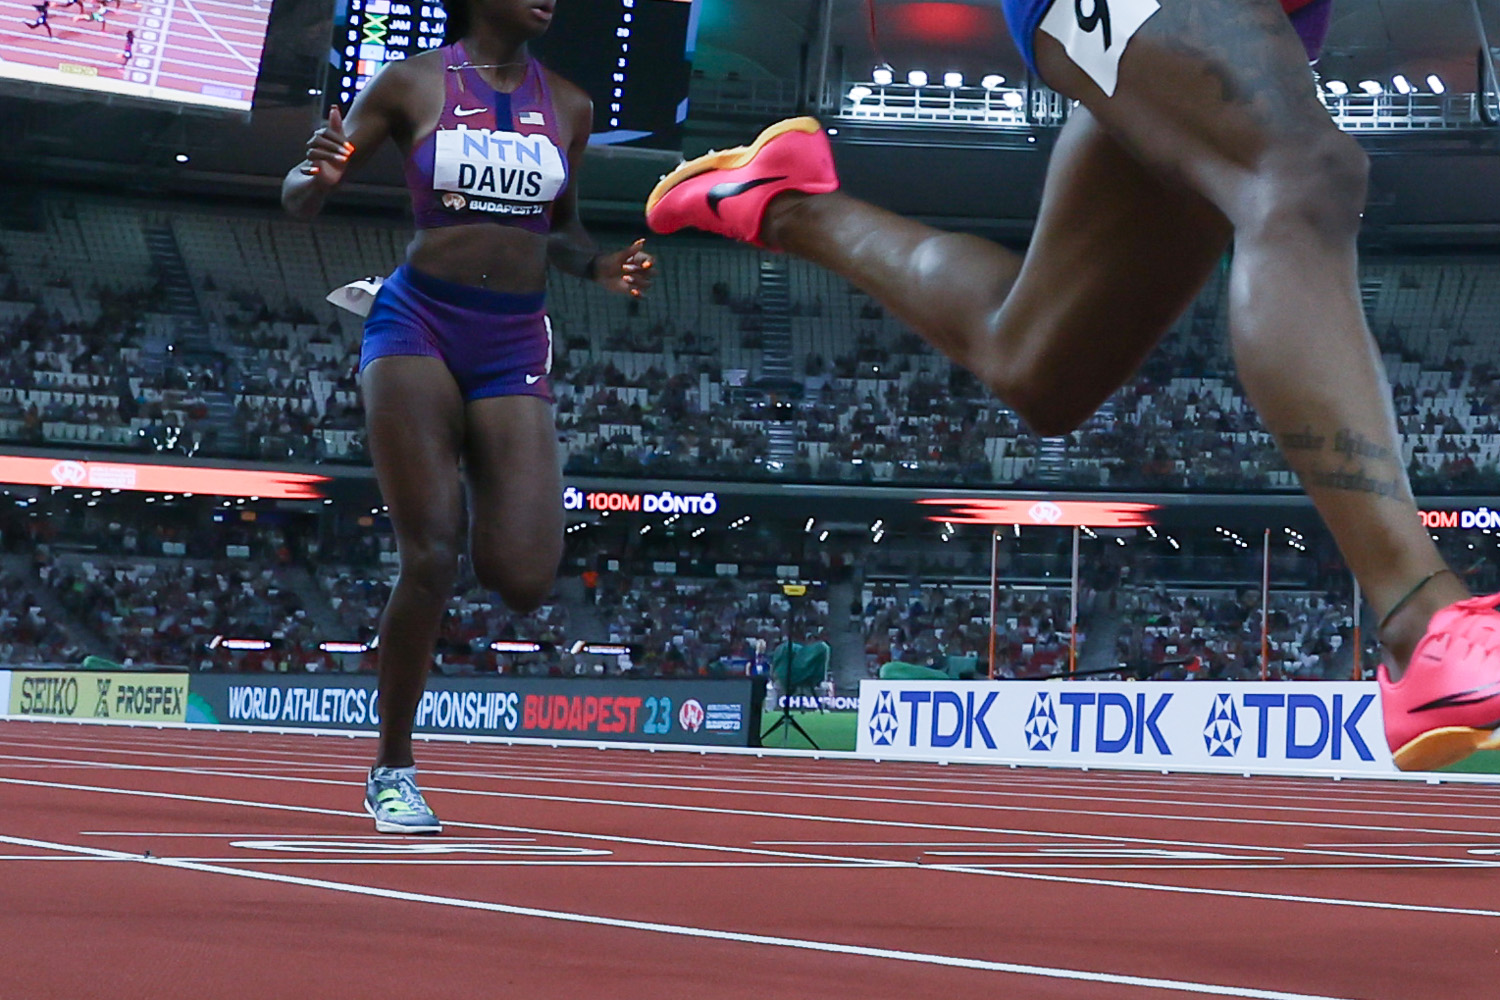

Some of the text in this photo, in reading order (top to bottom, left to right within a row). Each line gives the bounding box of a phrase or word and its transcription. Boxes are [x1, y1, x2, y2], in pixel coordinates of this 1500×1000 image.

[463, 133, 542, 166] NTN
[458, 163, 543, 197] DAVIS
[469, 200, 532, 215] BUDAPEST
[586, 493, 640, 511] 100M
[20, 677, 78, 715] SEIKO
[116, 685, 184, 716] PROSPEX
[228, 686, 280, 720] WORLD
[282, 687, 367, 724] ATHLETICS
[523, 693, 641, 734] BUDAPEST
[643, 696, 671, 735] 23
[900, 690, 1000, 749] TDK
[1060, 692, 1174, 755] TDK
[1243, 693, 1377, 761] TDK
